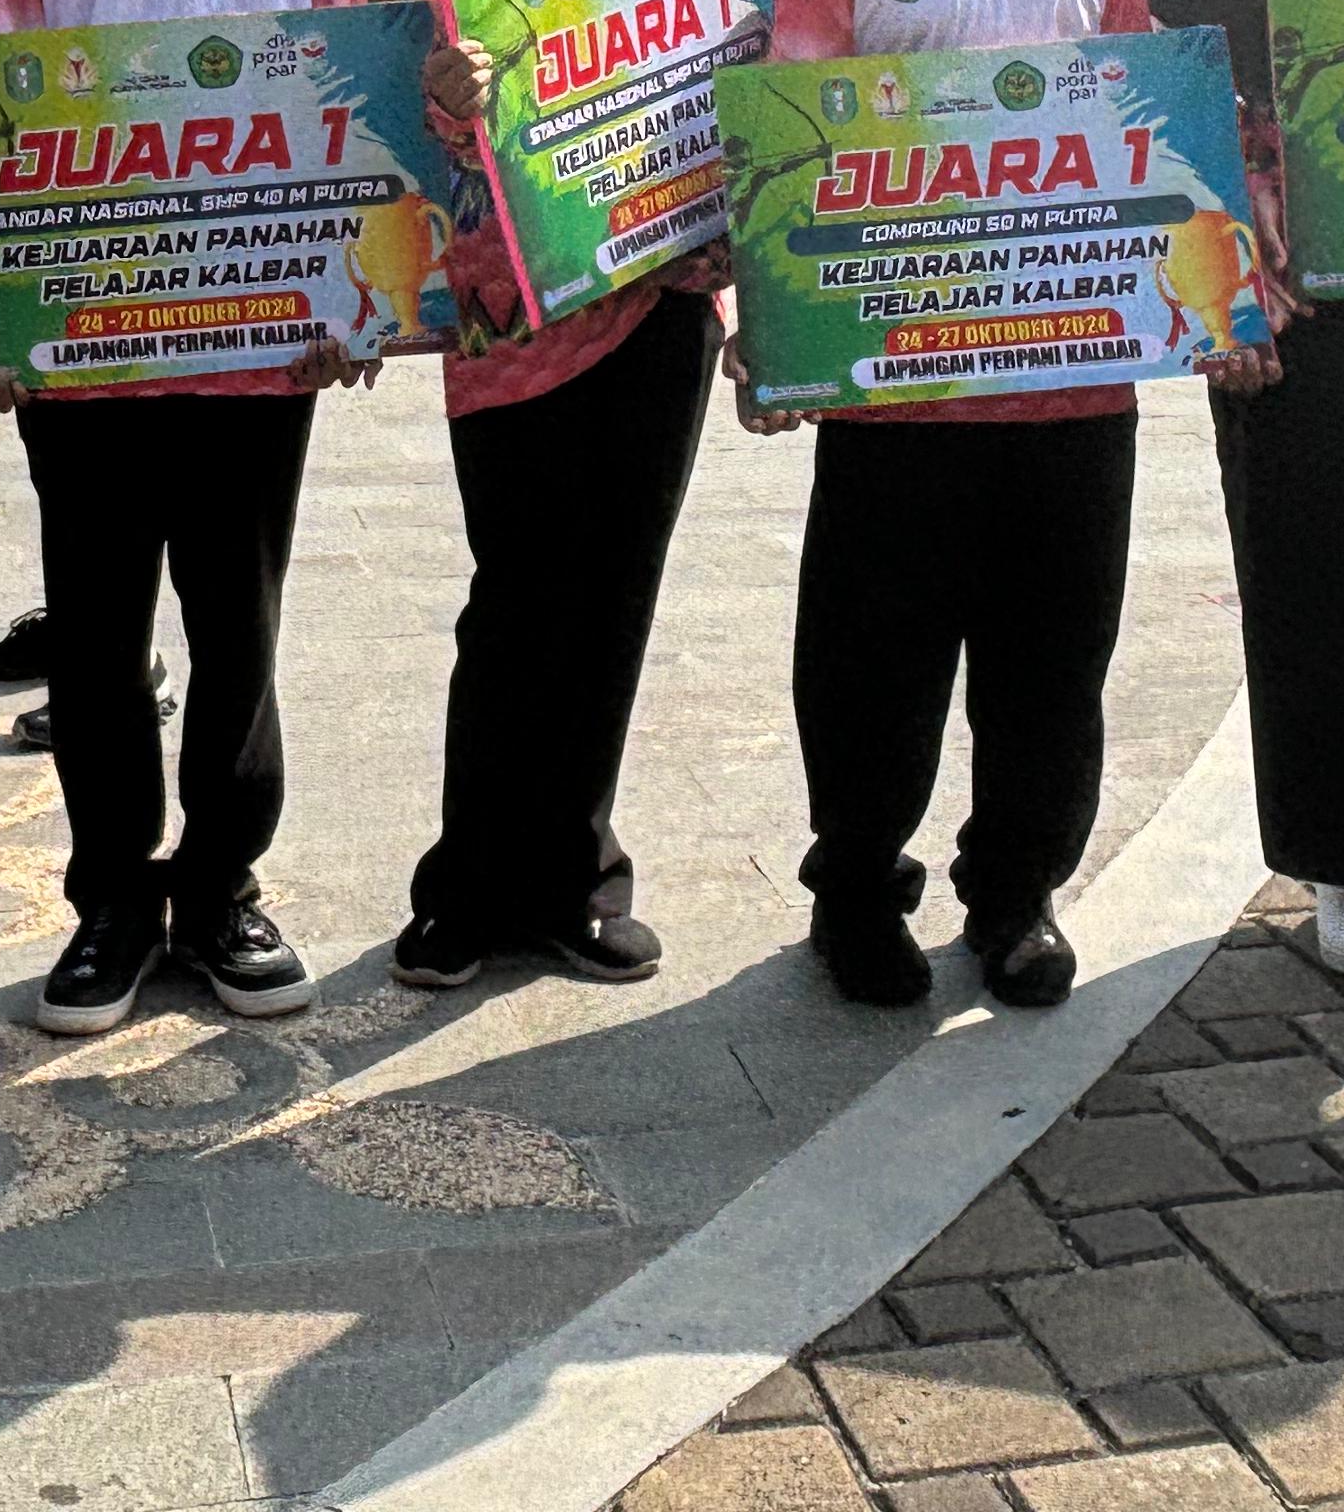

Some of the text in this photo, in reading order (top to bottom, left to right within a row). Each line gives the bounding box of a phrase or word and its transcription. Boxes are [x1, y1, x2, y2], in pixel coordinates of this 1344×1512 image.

[267, 64, 297, 80] par
[322, 107, 350, 166] 1
[555, 110, 669, 178] KEJUARAAN
[588, 146, 671, 202] PELAJAR
[815, 128, 1151, 214] JUARA 1
[79, 199, 194, 222] NASIONAL
[314, 180, 388, 200] PUTRA
[862, 220, 980, 242] COMPOUND
[1020, 214, 1039, 230] M
[1045, 205, 1118, 226] PUTRA
[1, 217, 363, 269] KEJUARAAN PANAHAN
[820, 235, 1169, 287] KEJUARAAN PANAHAN
[42, 256, 327, 302] PELAJAR KALBAR
[862, 273, 1137, 318] PELAJAR KALBAR
[121, 311, 144, 330] 27
[938, 329, 959, 347] 27
[53, 337, 156, 365] LAPANGAN
[873, 354, 974, 381] LAPANGAN
